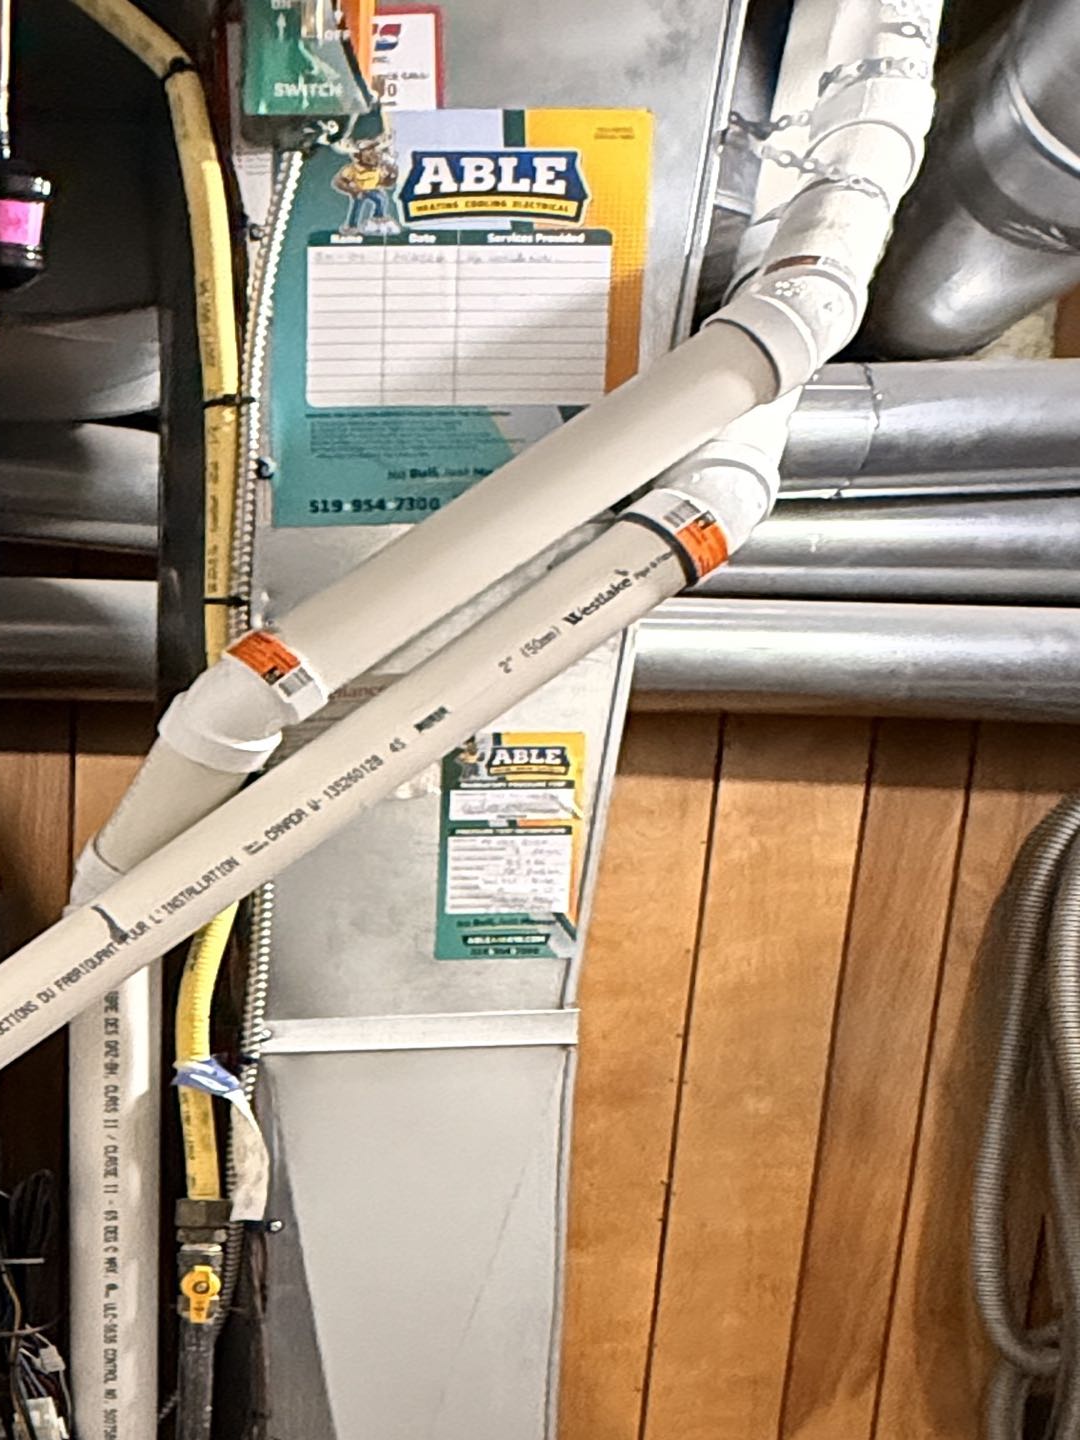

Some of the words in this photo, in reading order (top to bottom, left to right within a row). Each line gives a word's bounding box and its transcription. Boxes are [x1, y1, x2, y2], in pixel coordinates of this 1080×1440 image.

[274, 82, 344, 97] SWITCH
[414, 157, 567, 195] ABLE
[416, 201, 459, 212] HEATING
[464, 200, 507, 209] COOLING
[512, 201, 569, 213] ELECTRICAL
[536, 233, 585, 243] Provided
[492, 749, 562, 765] ABLE
[36, 985, 56, 1005] DU
[54, 940, 119, 992] FABRIQUANT
[263, 806, 307, 843] CANADA
[565, 575, 633, 625] Westlake
[104, 1085, 119, 1113] CLASS
[104, 1349, 118, 1383] CONTROL
